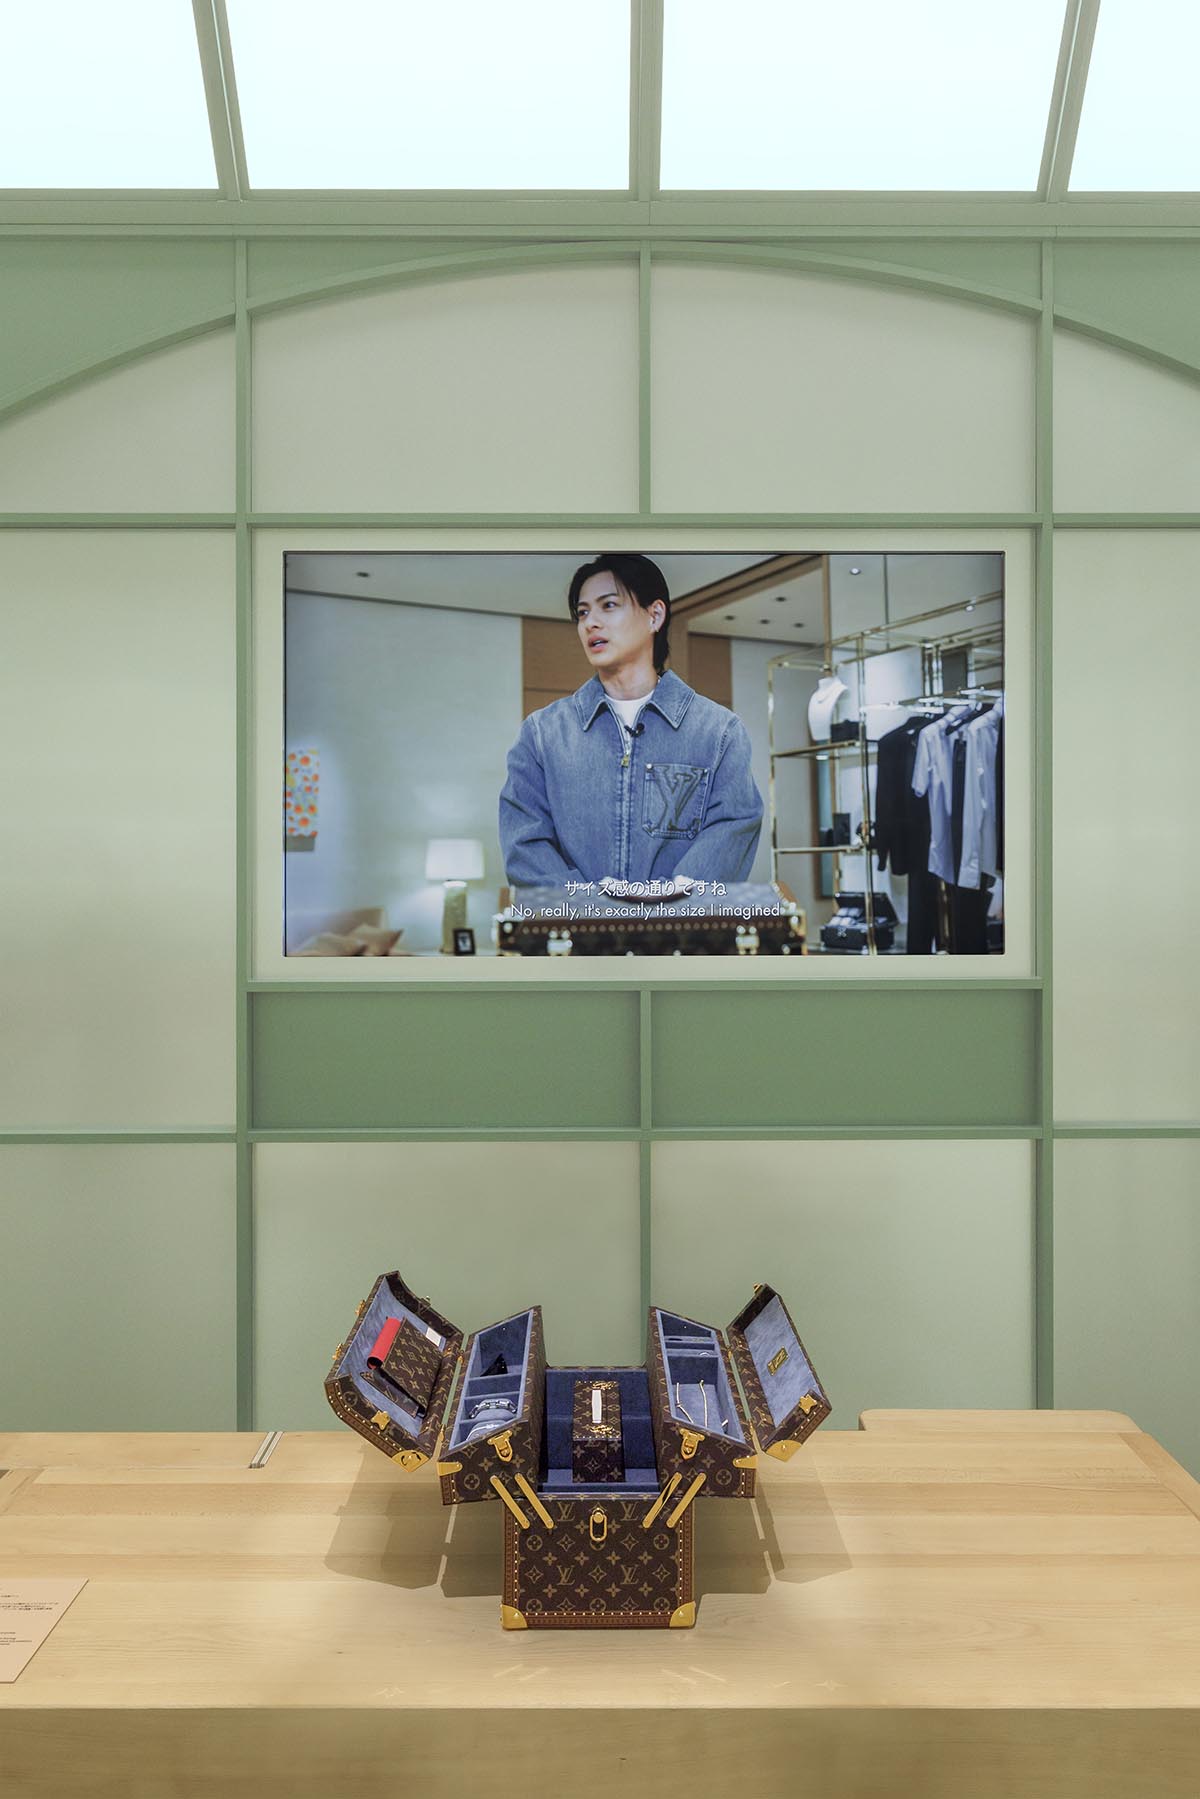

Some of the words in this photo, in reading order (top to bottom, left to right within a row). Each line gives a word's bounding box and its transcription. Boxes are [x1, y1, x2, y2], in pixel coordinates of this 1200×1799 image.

[564, 879, 727, 897] サイズ感の通りですね
[511, 904, 536, 919] No,
[540, 904, 580, 920] really,
[584, 904, 602, 917] it's
[606, 904, 651, 920] exactly
[656, 904, 676, 917] the
[680, 904, 705, 917] size
[718, 904, 780, 920] imagined
